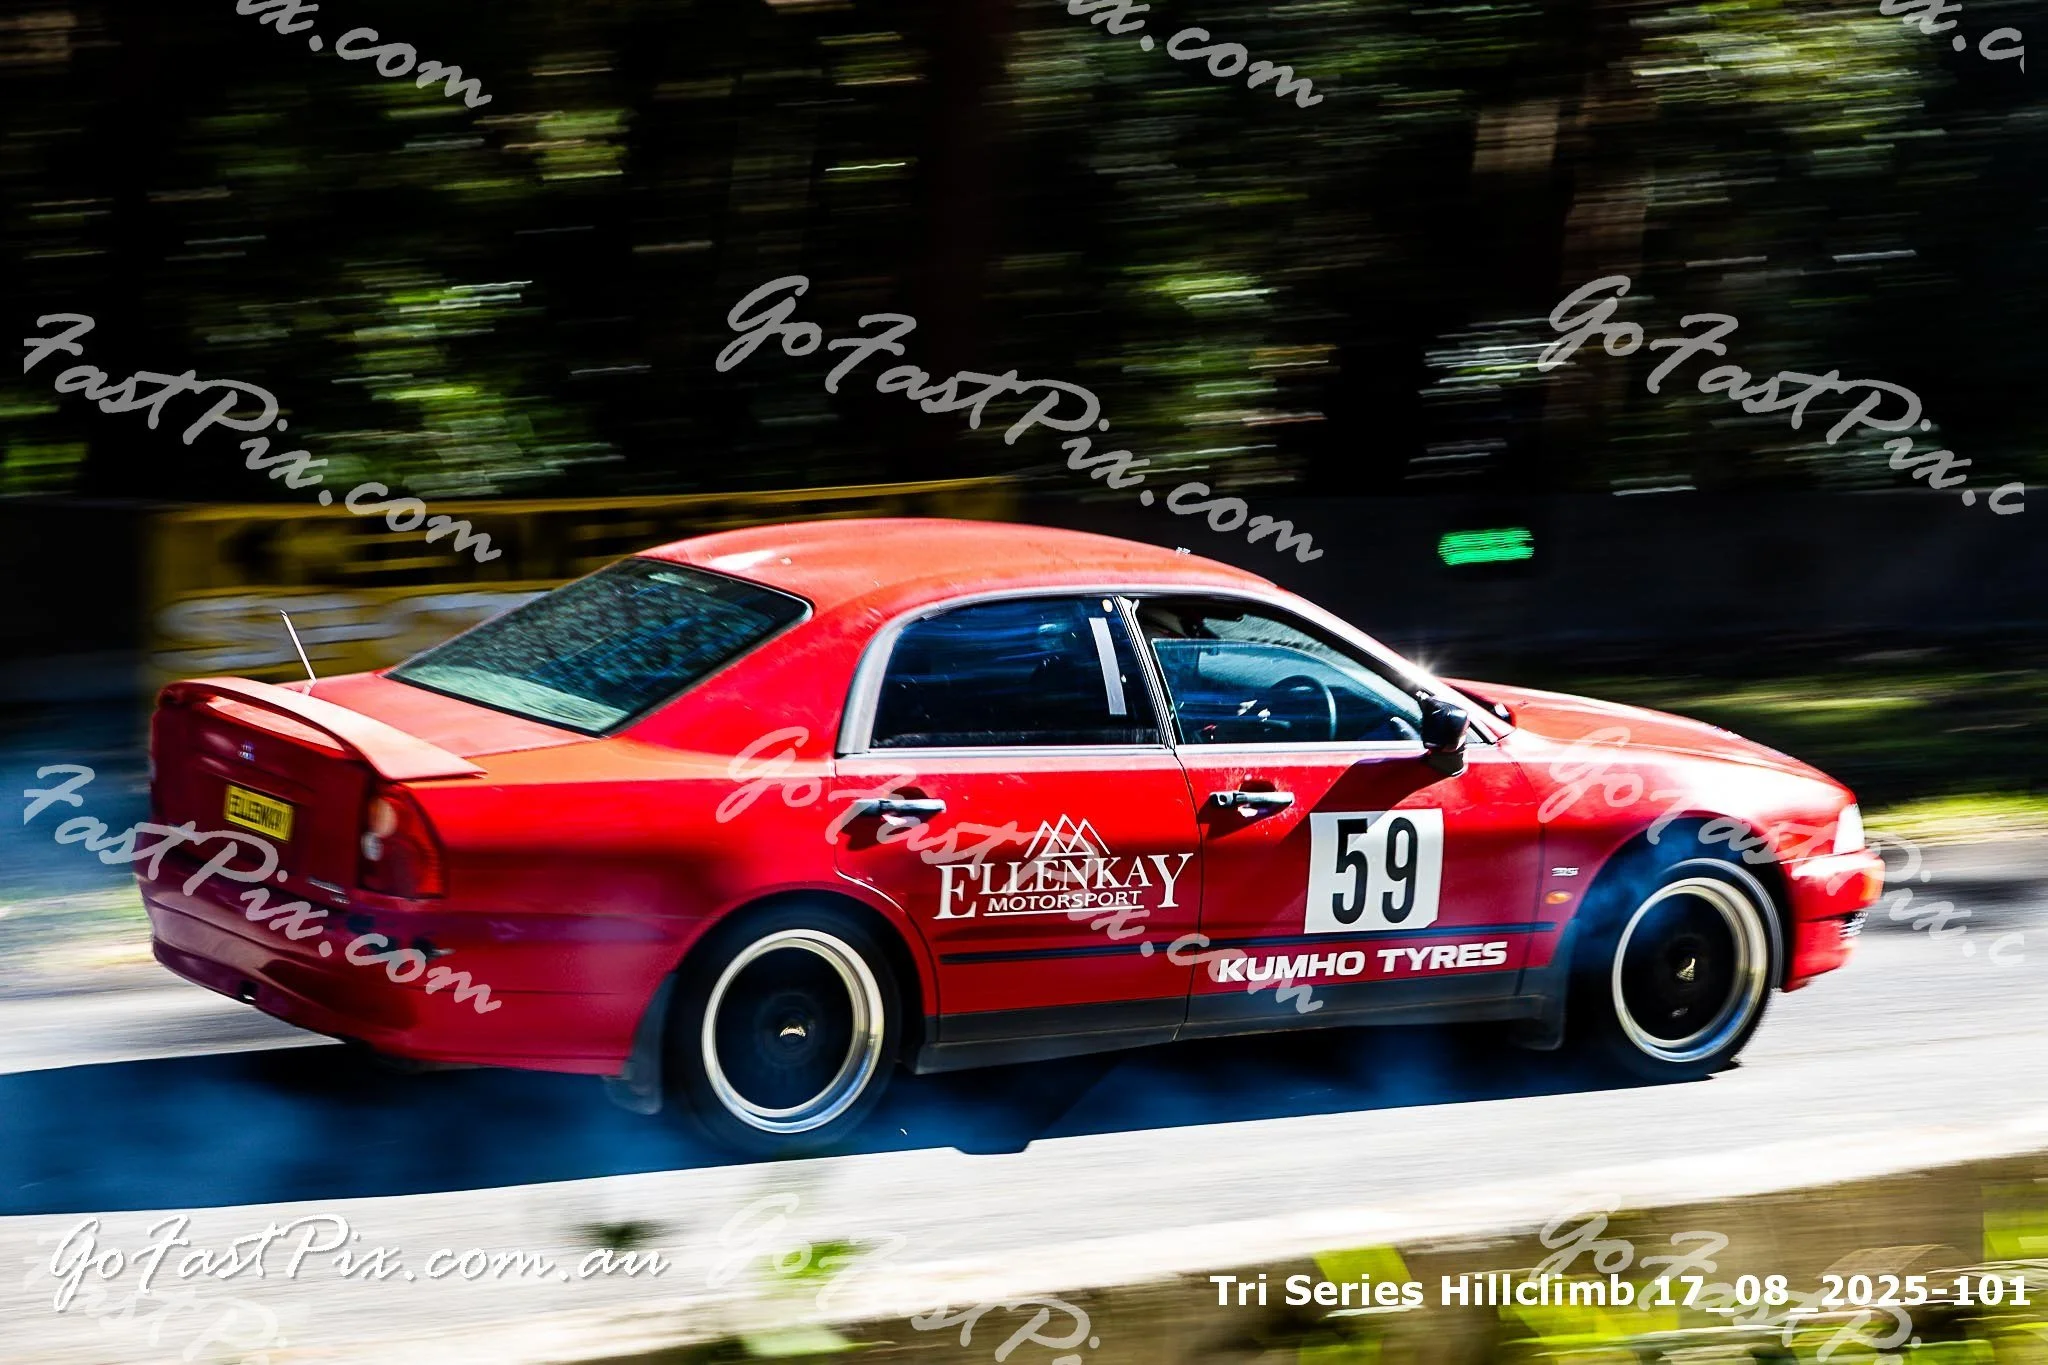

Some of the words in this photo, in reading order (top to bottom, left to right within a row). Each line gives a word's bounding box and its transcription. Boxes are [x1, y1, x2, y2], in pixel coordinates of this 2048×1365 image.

[932, 853, 1194, 920] ELLENKAY
[1332, 816, 1418, 925] 59
[987, 890, 1142, 912] MOTORSPORT
[1218, 951, 1366, 983] KUMHO
[1376, 941, 1508, 973] TYRES
